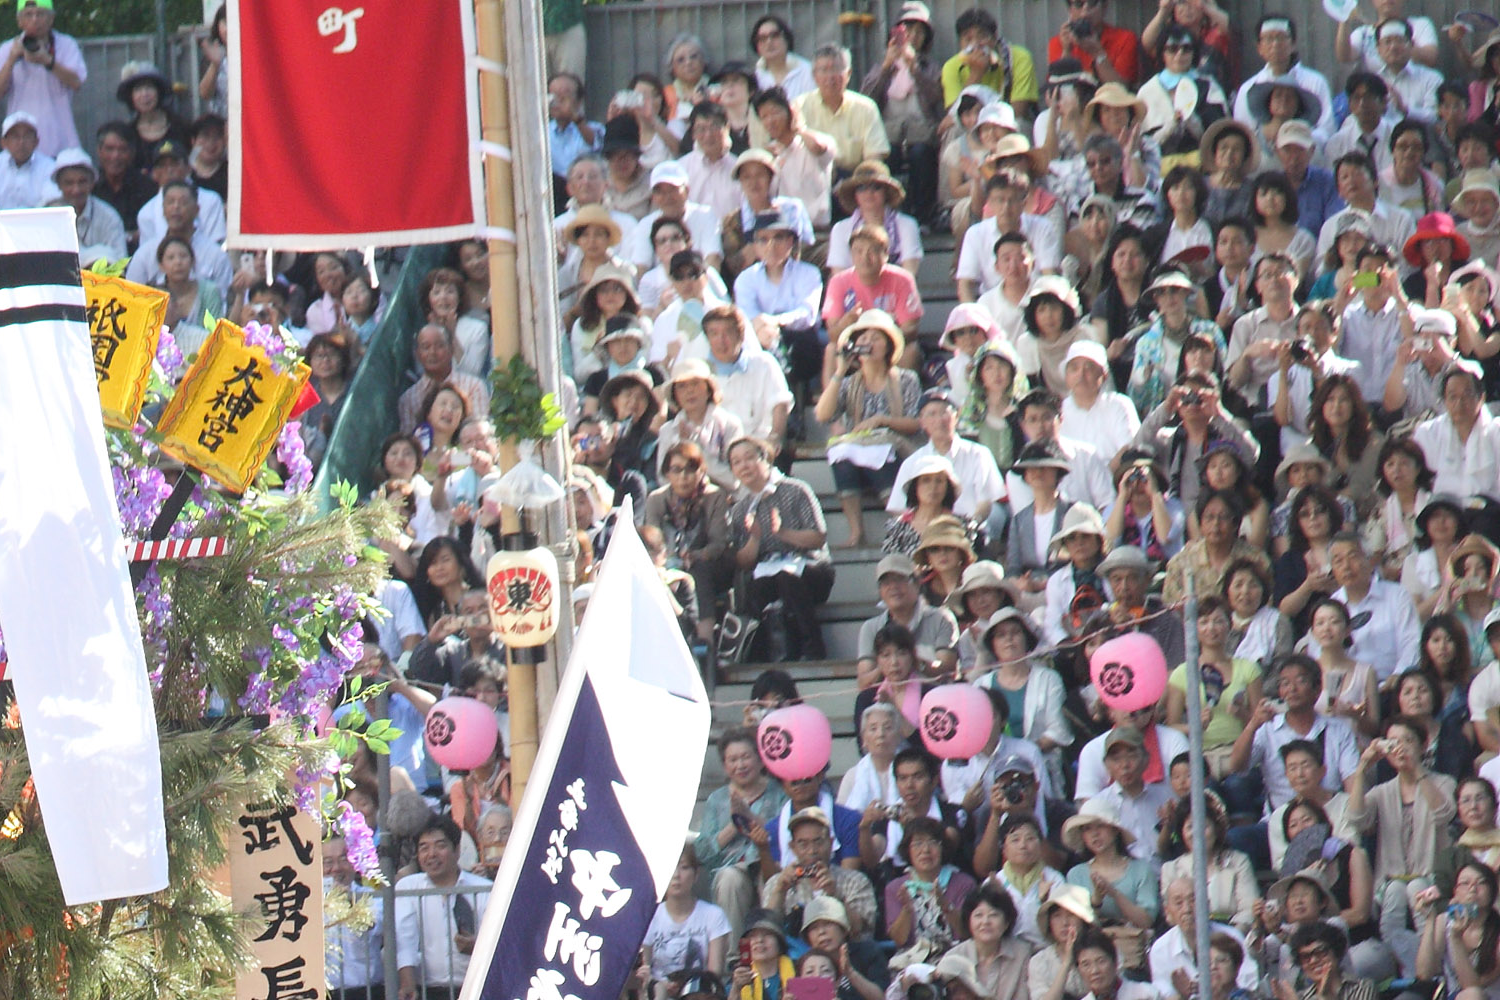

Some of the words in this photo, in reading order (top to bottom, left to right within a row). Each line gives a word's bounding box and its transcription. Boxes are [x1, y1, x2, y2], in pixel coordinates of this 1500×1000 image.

[317, 6, 365, 54] 町
[87, 298, 128, 391] 祇園
[199, 357, 264, 454] 大神宮
